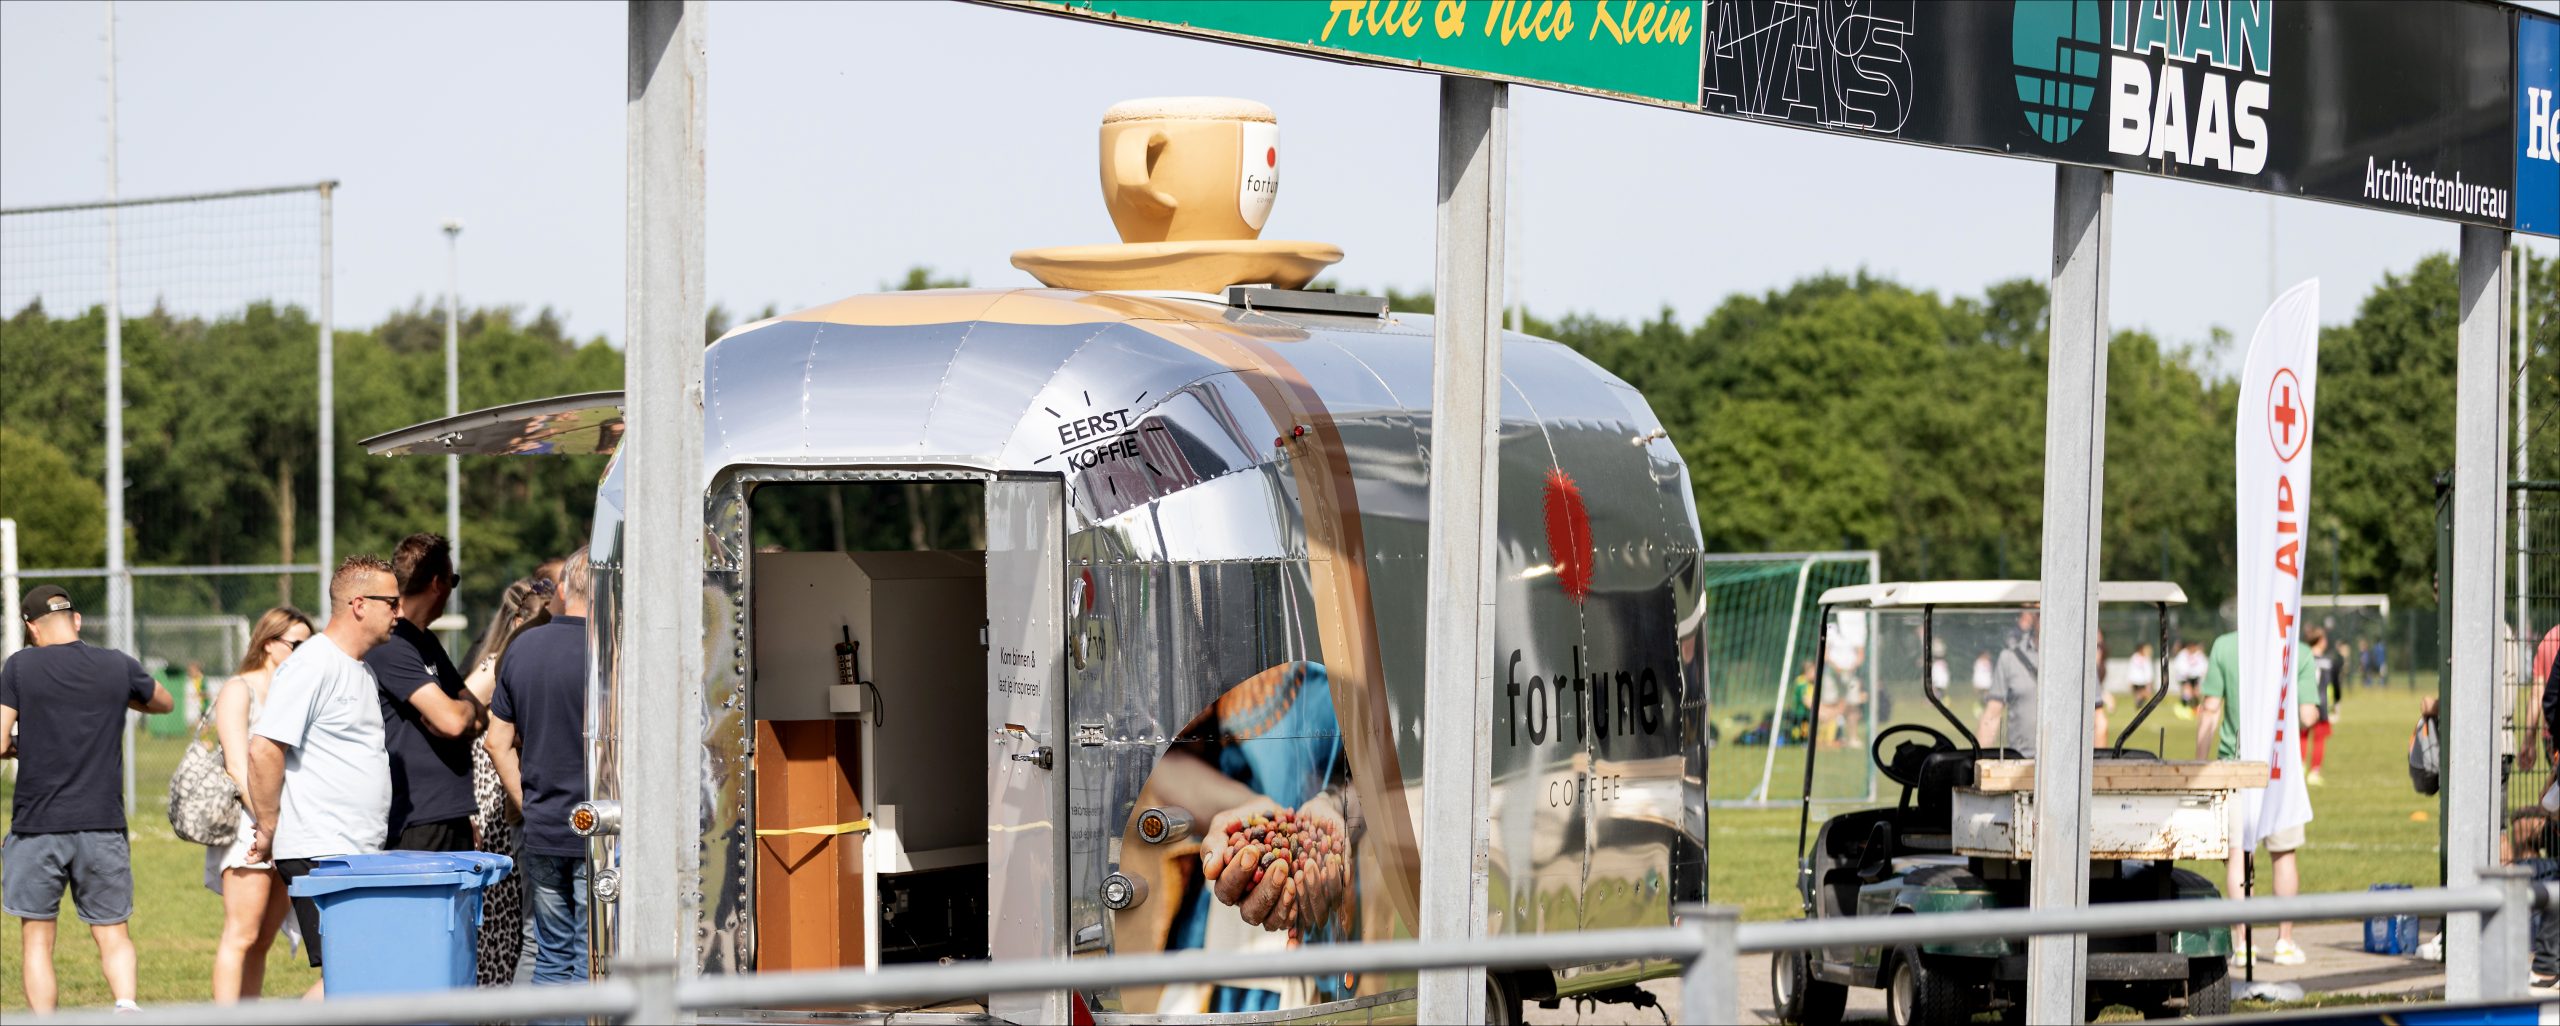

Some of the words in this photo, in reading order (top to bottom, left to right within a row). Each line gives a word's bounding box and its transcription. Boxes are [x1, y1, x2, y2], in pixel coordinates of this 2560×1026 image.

[1434, 0, 1467, 40] &
[1484, 0, 1575, 46] Nico
[1589, 0, 1693, 46] Klein
[2108, 55, 2270, 175] BAAS
[2363, 155, 2508, 219] Architectenbureau
[1058, 408, 1130, 446] EERST
[1067, 438, 1141, 474] KOFFIE
[2275, 475, 2299, 578] AID
[1000, 646, 1012, 665] Kom
[1506, 645, 1660, 747] fortune
[2270, 602, 2294, 780] FIRST
[1549, 774, 1621, 808] COFFEE
